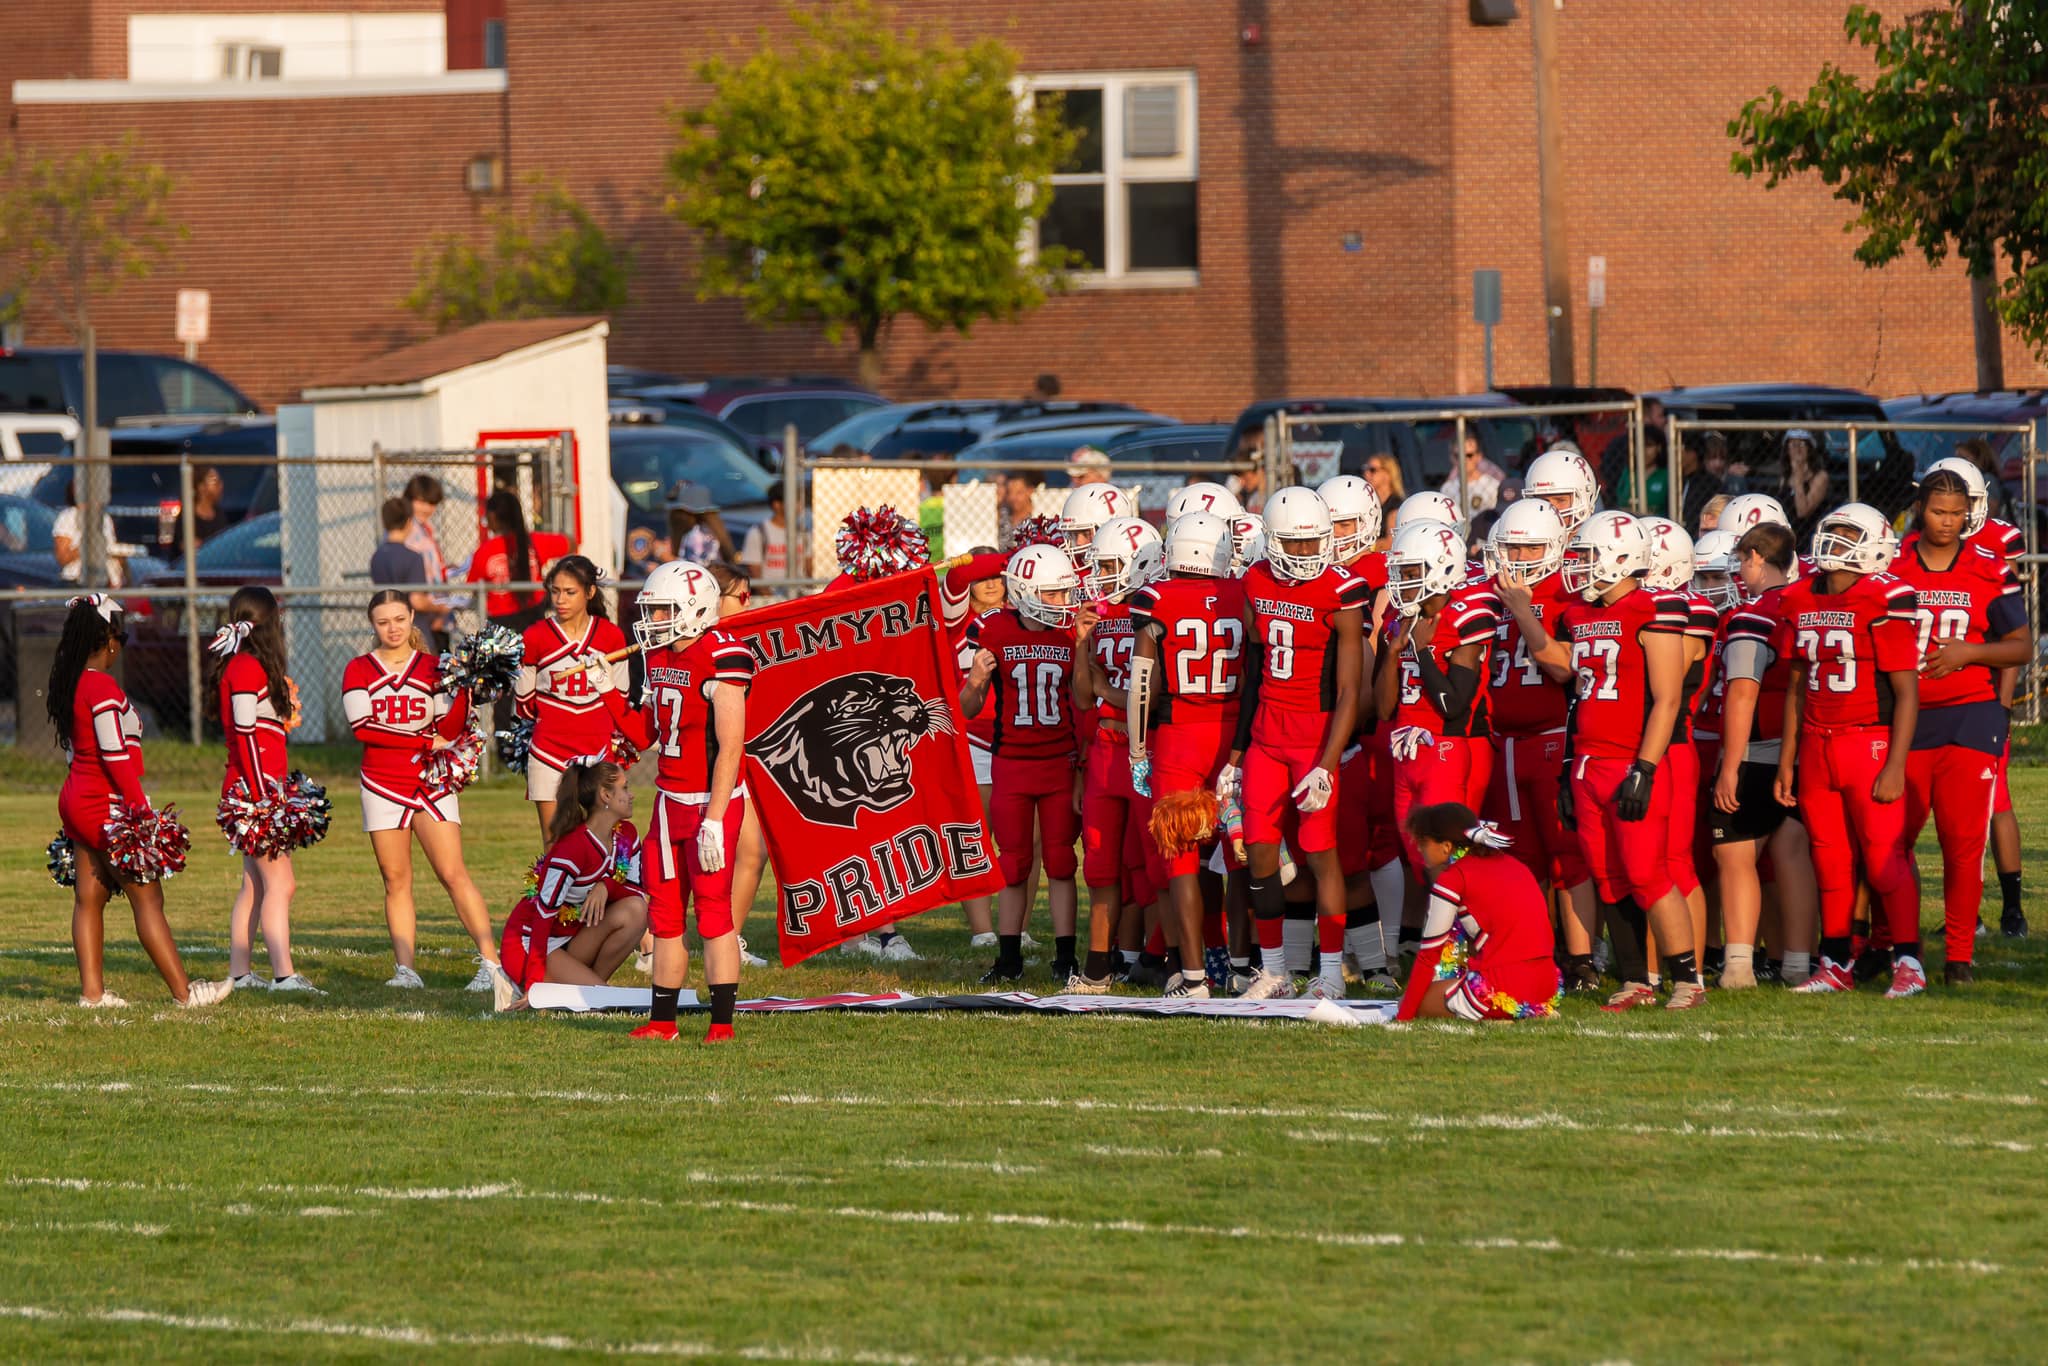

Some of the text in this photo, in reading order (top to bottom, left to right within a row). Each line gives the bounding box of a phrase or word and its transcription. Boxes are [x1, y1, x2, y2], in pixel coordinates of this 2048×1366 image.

[1099, 490, 1118, 515] P
[1201, 494, 1216, 513] 7
[1121, 524, 1143, 551] P
[1607, 516, 1632, 538] P
[1434, 529, 1454, 557] P
[1014, 558, 1036, 580] 10
[1179, 564, 1210, 574] Riddell
[1331, 566, 1350, 579] 8
[679, 569, 703, 596] P
[1205, 597, 1217, 610] P
[1255, 598, 1314, 622] PALMYRA
[1915, 591, 1972, 607] ALMYRA
[1573, 620, 1622, 640] PALMYRA
[1799, 611, 1855, 628] PALMYRA
[741, 591, 939, 675] ALMYRA
[1004, 645, 1071, 661] PALMYRA
[1175, 618, 1243, 695] 22
[1268, 619, 1294, 680] 8
[1797, 629, 1857, 693] 73
[650, 667, 691, 687] PALMYRA
[1571, 638, 1621, 700] 67
[550, 667, 598, 696] PH
[1011, 662, 1063, 726] 10
[371, 695, 427, 724] PHS
[1871, 741, 1888, 760] P
[784, 819, 993, 935] PRIDE
